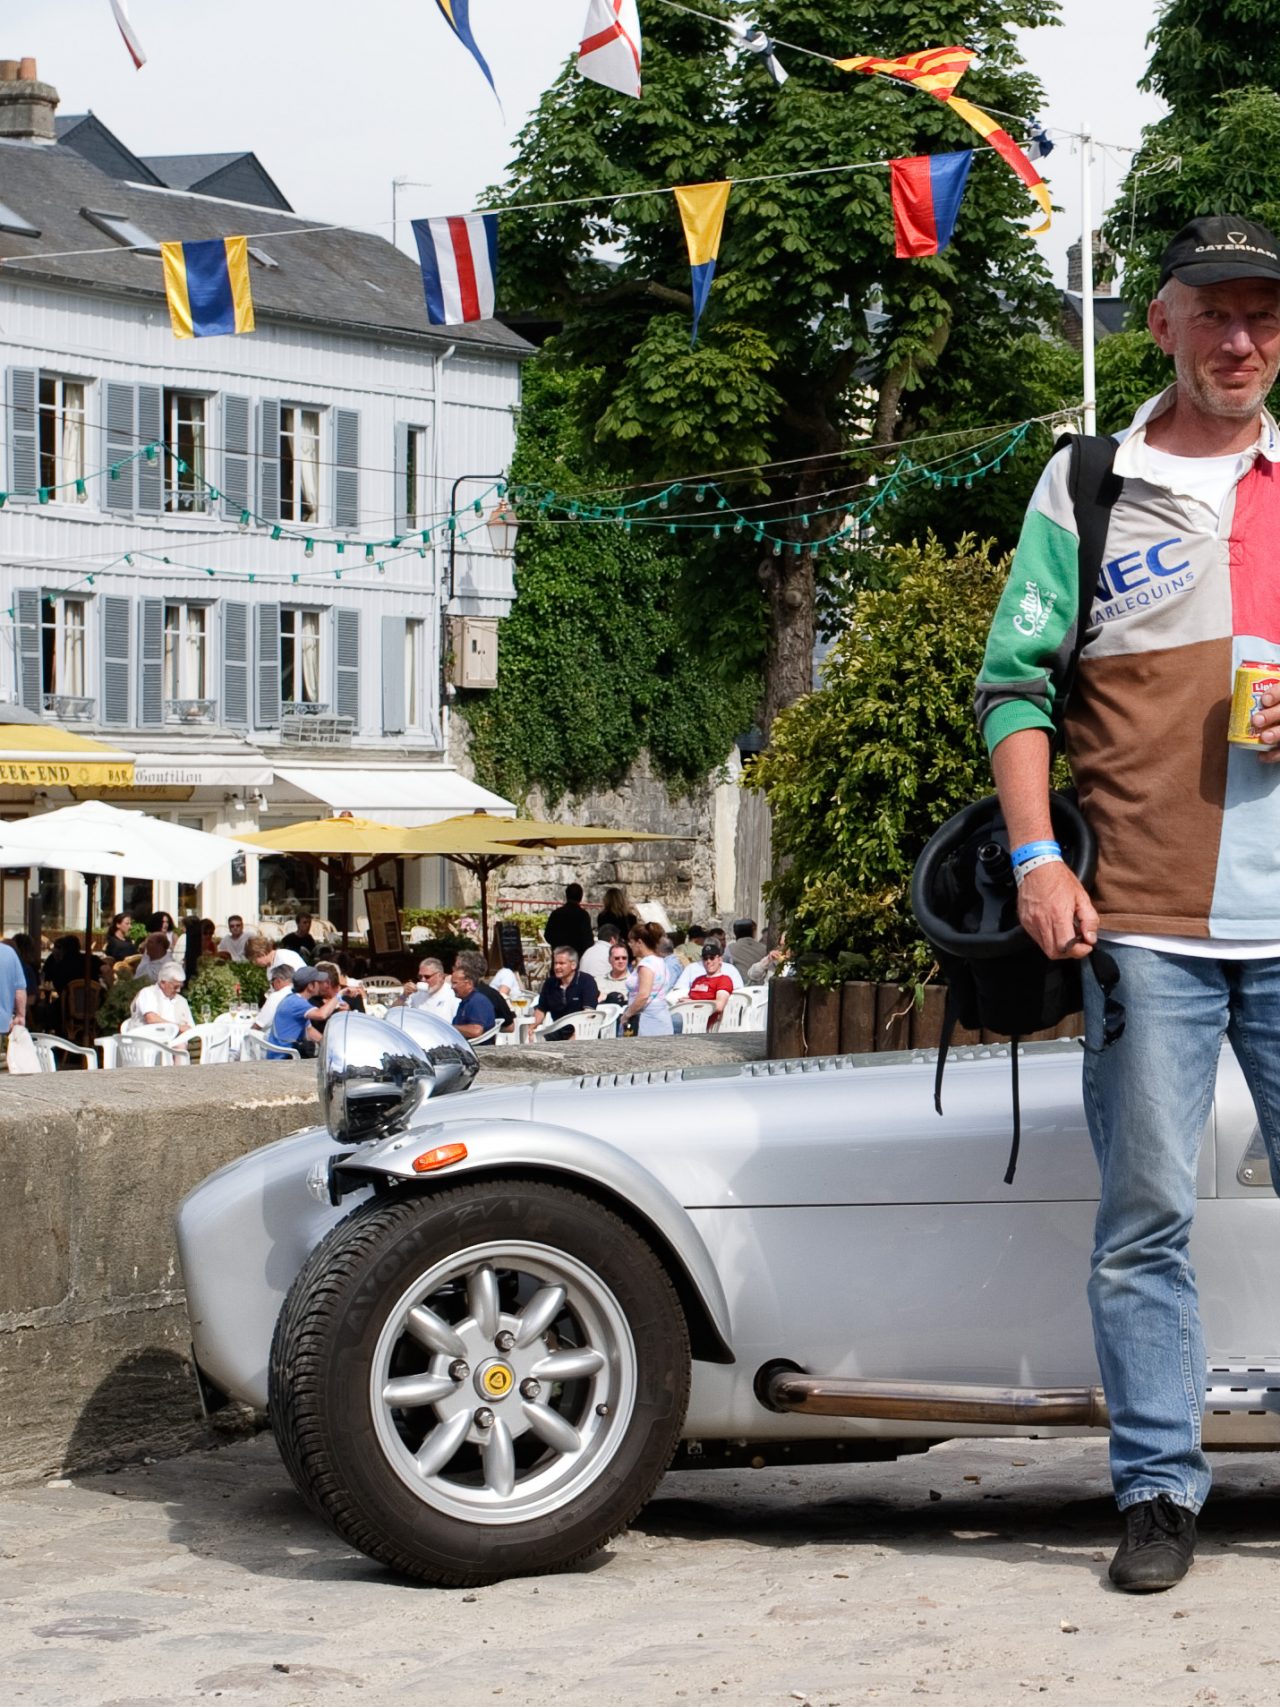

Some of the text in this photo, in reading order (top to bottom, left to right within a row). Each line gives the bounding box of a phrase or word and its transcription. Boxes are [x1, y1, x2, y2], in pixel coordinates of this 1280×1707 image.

[1195, 244, 1278, 260] CATERHAM
[1012, 581, 1038, 637] Cotton
[1089, 572, 1195, 626] ARLEQUINS
[0, 765, 128, 782] EEK-END BAR
[346, 1231, 427, 1332] AVON
